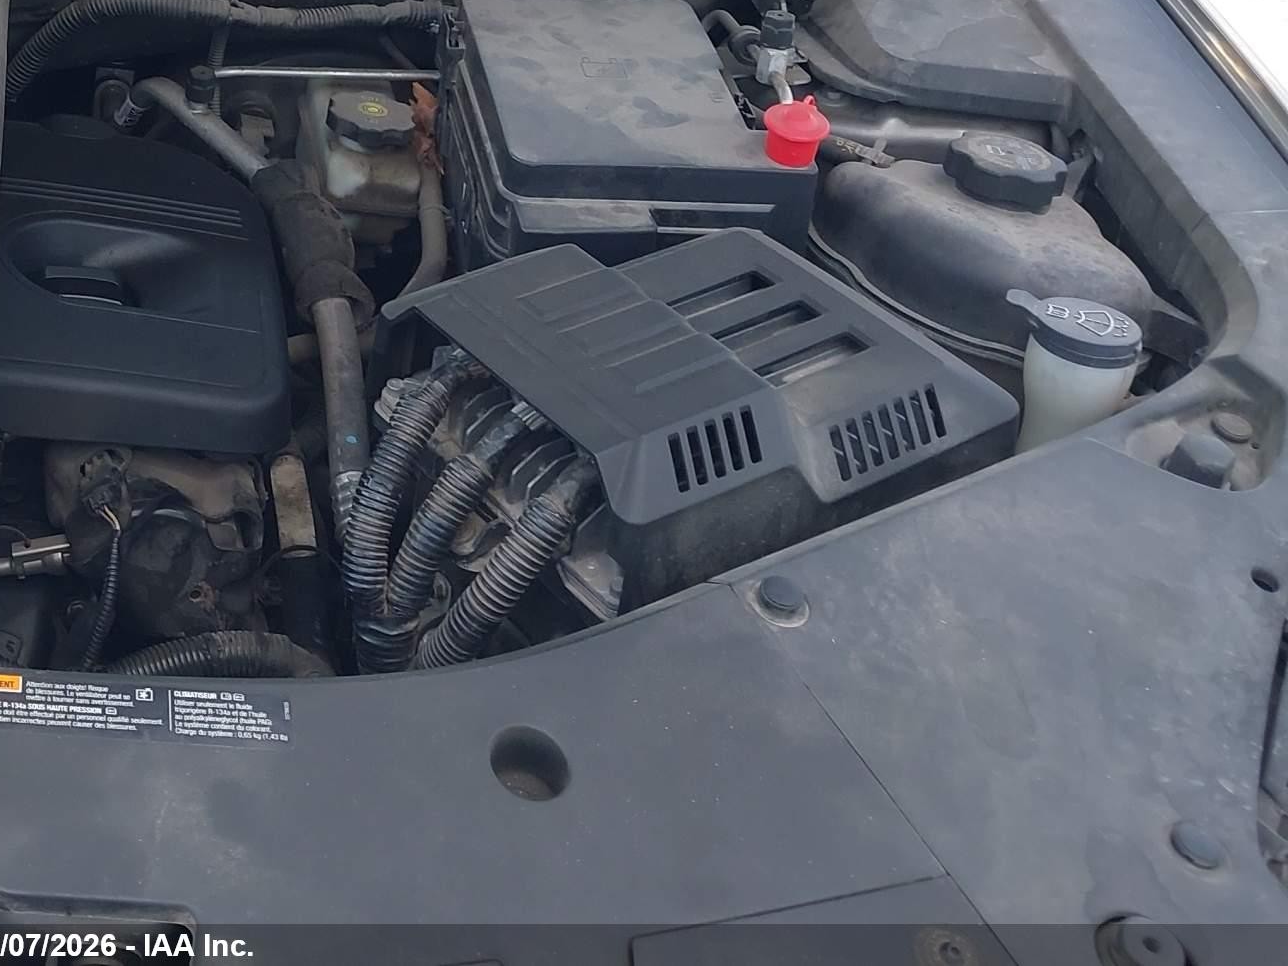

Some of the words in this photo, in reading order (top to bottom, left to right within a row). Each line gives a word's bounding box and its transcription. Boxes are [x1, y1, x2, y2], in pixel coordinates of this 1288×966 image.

[174, 691, 217, 699] CLIMATISEUR
[46, 704, 68, 712] HAUTE
[70, 706, 102, 714] PRESSION
[176, 728, 197, 736] Charge
